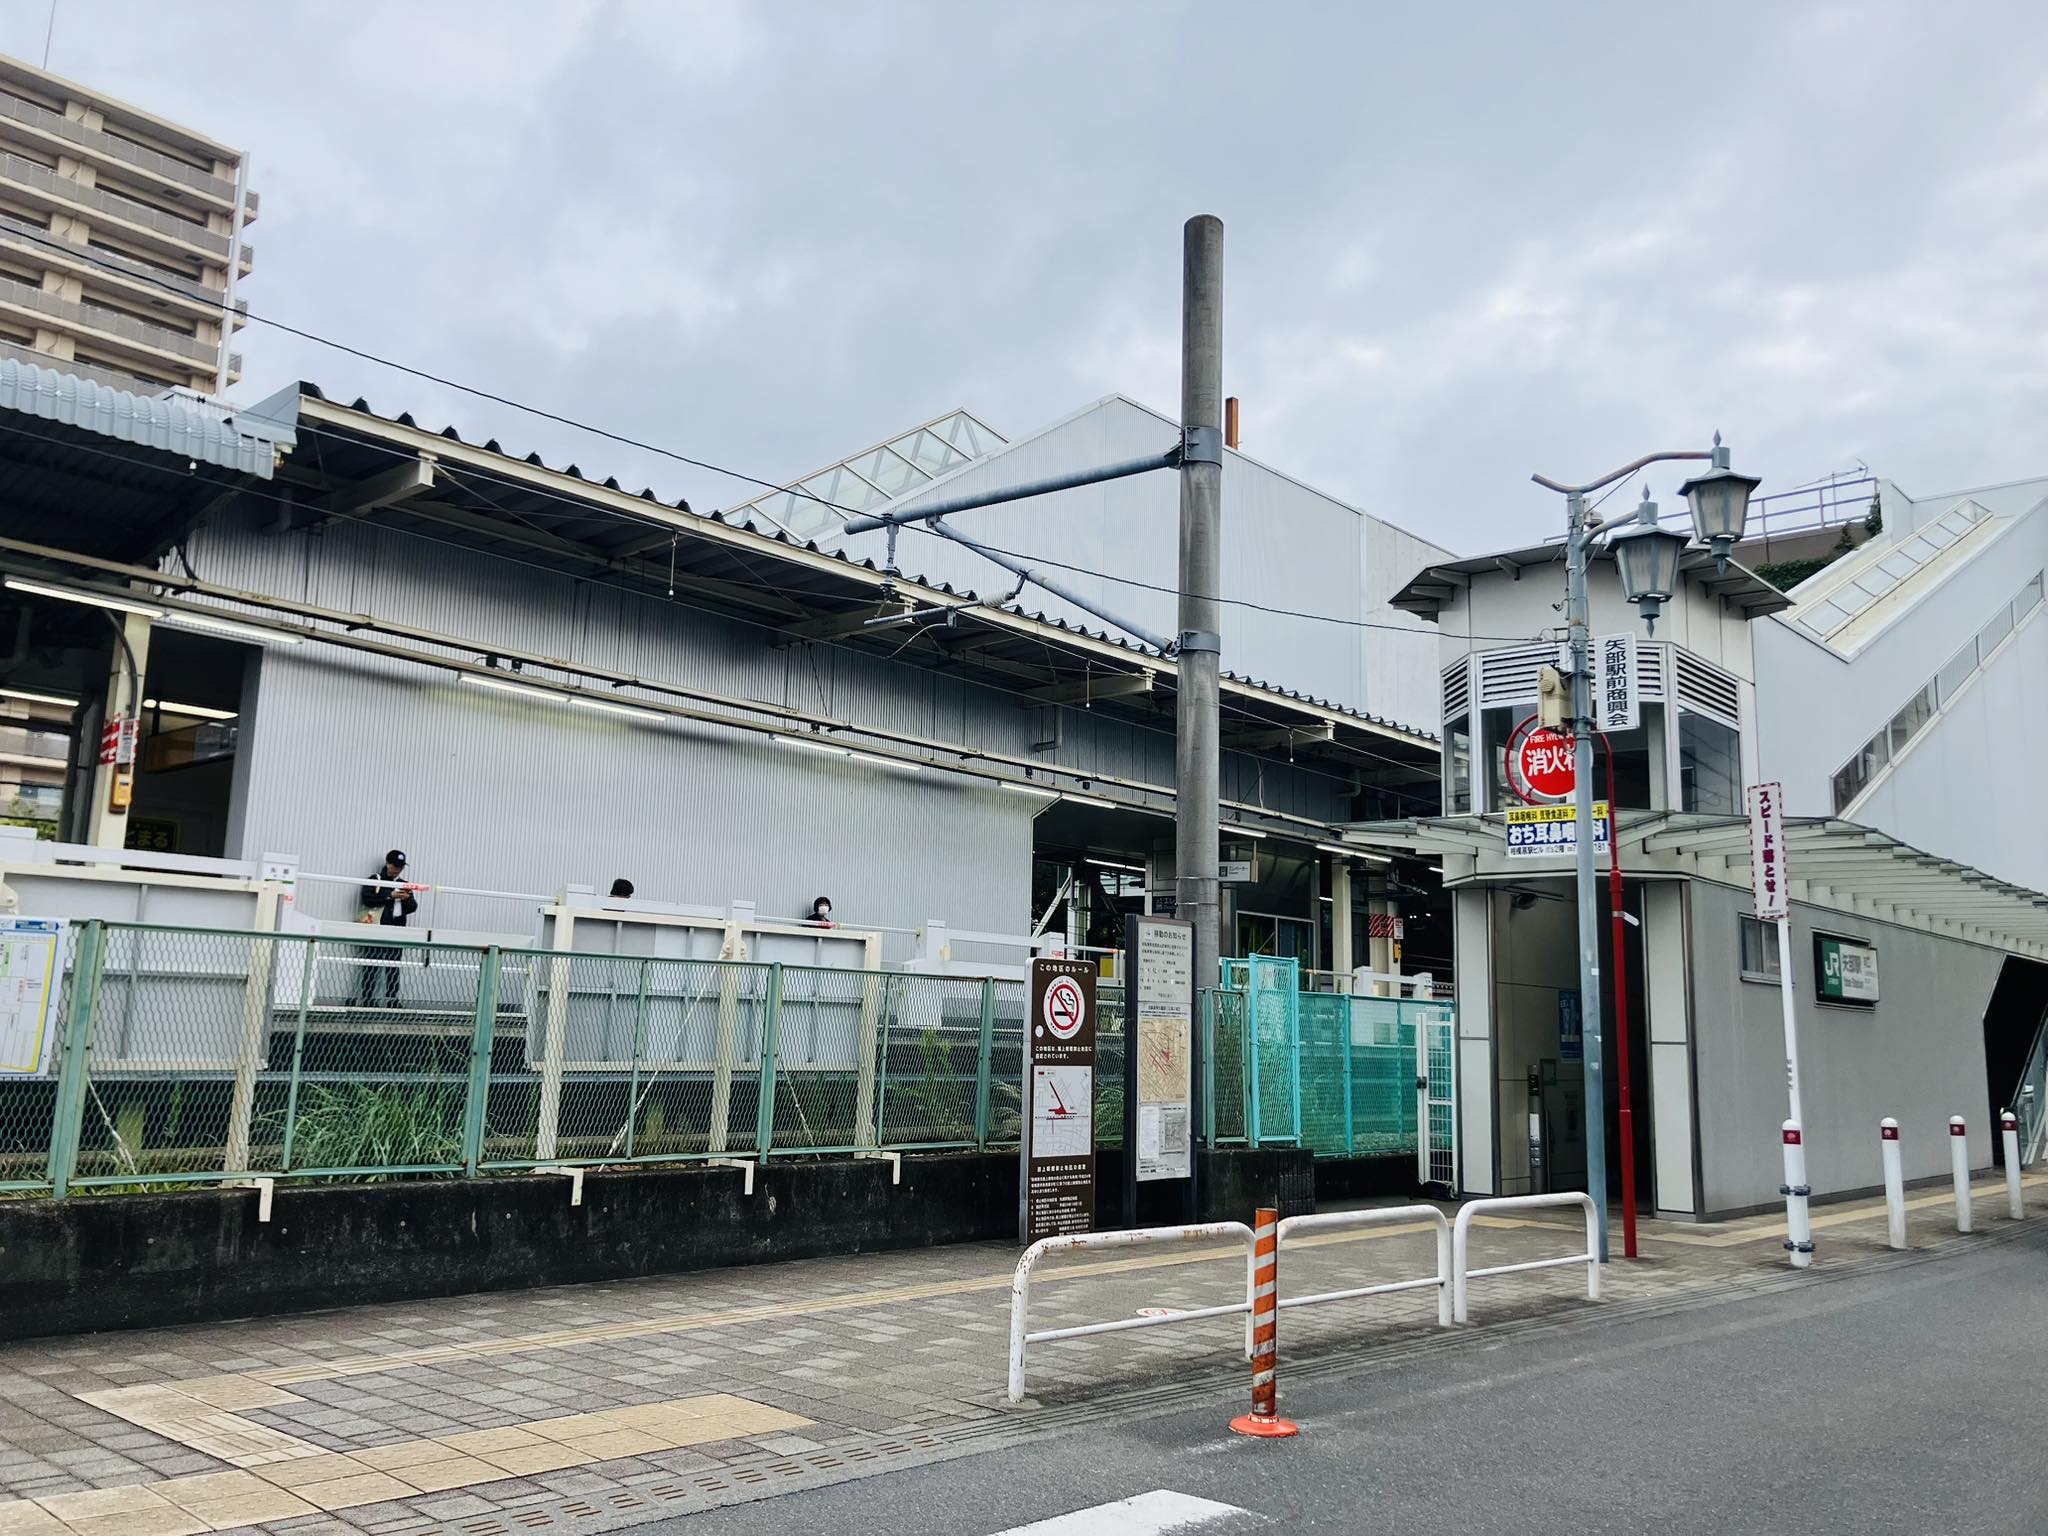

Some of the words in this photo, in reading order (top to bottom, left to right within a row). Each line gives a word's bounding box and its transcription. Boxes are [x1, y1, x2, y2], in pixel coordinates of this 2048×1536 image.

[1604, 639, 1628, 726] 矢部駅前商興会
[1530, 734, 1546, 744] FIRE
[1825, 952, 1840, 976] JR
